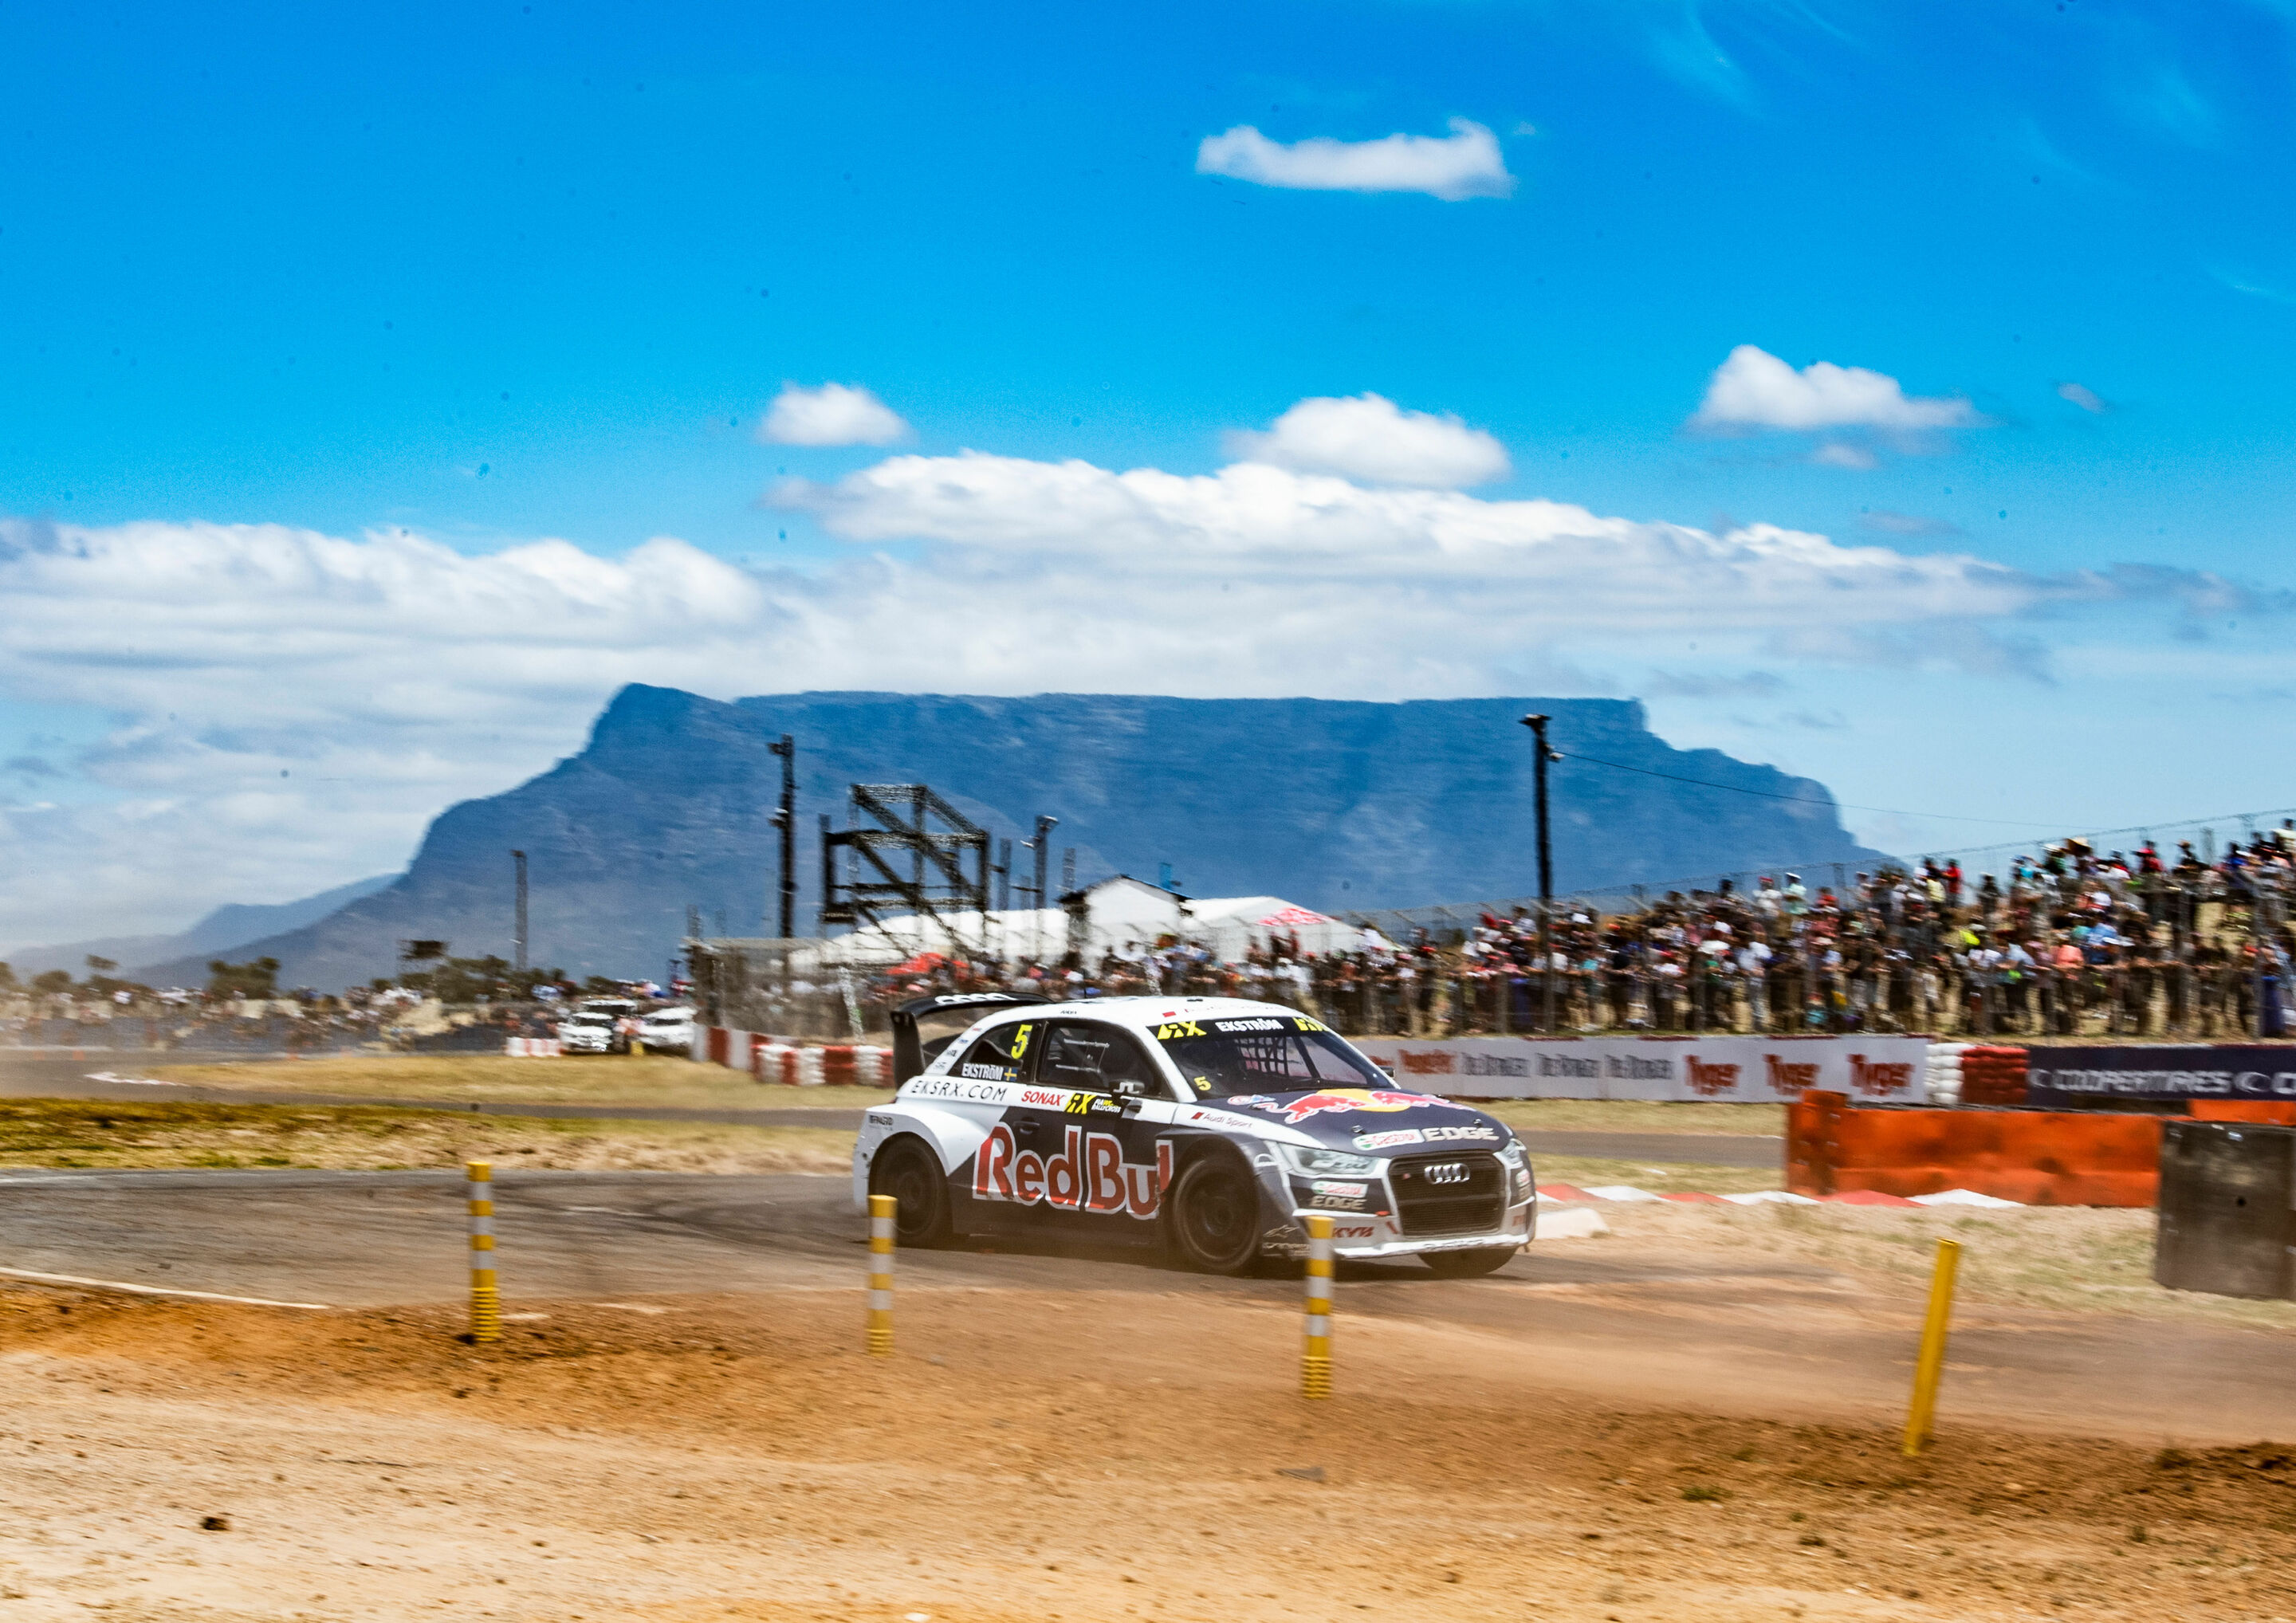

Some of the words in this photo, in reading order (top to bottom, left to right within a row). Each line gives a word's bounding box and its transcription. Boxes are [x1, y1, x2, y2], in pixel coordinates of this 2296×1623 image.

[1215, 1018, 1284, 1032] EKSTRÖM
[1010, 1024, 1032, 1059] 5
[961, 1063, 1005, 1080] EKSTRÖM
[911, 1079, 1008, 1102] EKSRX.COM
[1193, 1076, 1212, 1091] 5
[1021, 1090, 1065, 1106] SONAX
[1203, 1113, 1225, 1123] Audi
[1226, 1117, 1253, 1129] Sport
[1422, 1127, 1500, 1142] EDGE
[1310, 1195, 1368, 1211] EDGE
